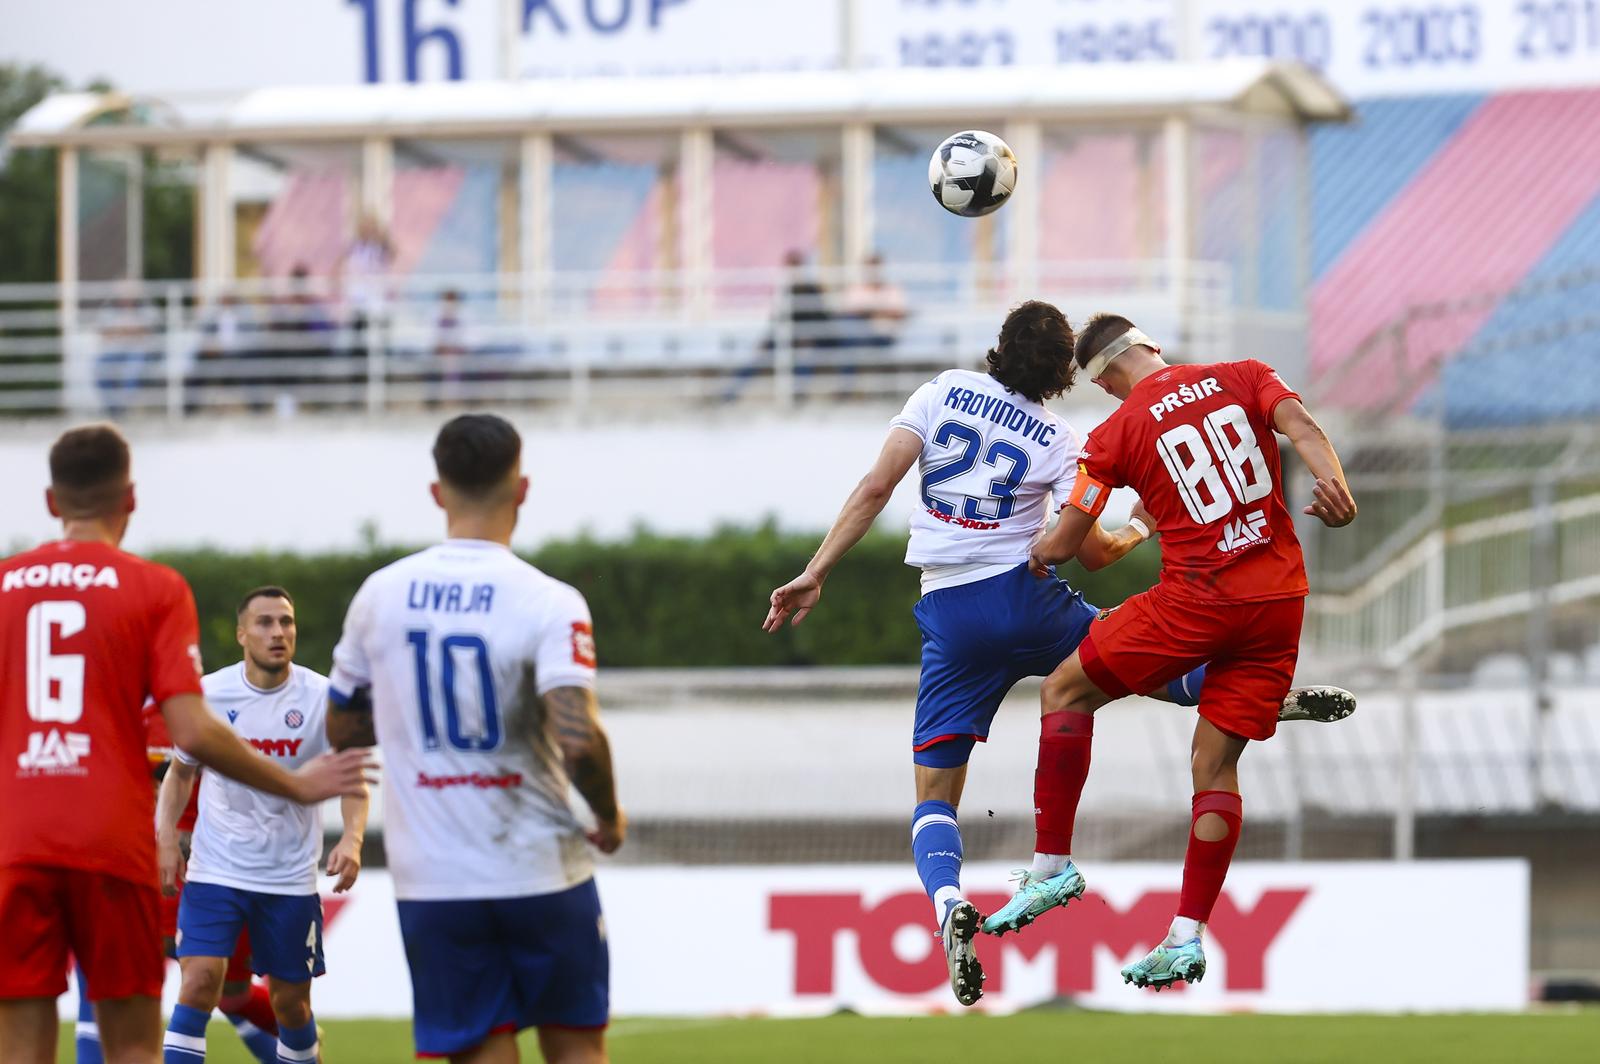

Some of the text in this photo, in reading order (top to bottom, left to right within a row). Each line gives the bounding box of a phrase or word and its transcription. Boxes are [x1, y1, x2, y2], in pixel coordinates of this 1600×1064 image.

[1362, 5, 1481, 65] 2003
[1515, 0, 1600, 55] 201
[944, 386, 1057, 448] KROVINOVIĆ
[1149, 377, 1223, 422] PRŠIR
[921, 419, 1031, 520] 23
[1156, 404, 1273, 525] 88
[1216, 509, 1268, 552] JAF
[407, 579, 495, 613] LIVAJA
[26, 600, 87, 724] 6
[405, 629, 504, 752] 10
[17, 727, 91, 769] JAF
[249, 738, 304, 758] MMY
[305, 919, 317, 955] 4
[768, 887, 1312, 995] TOMMY
